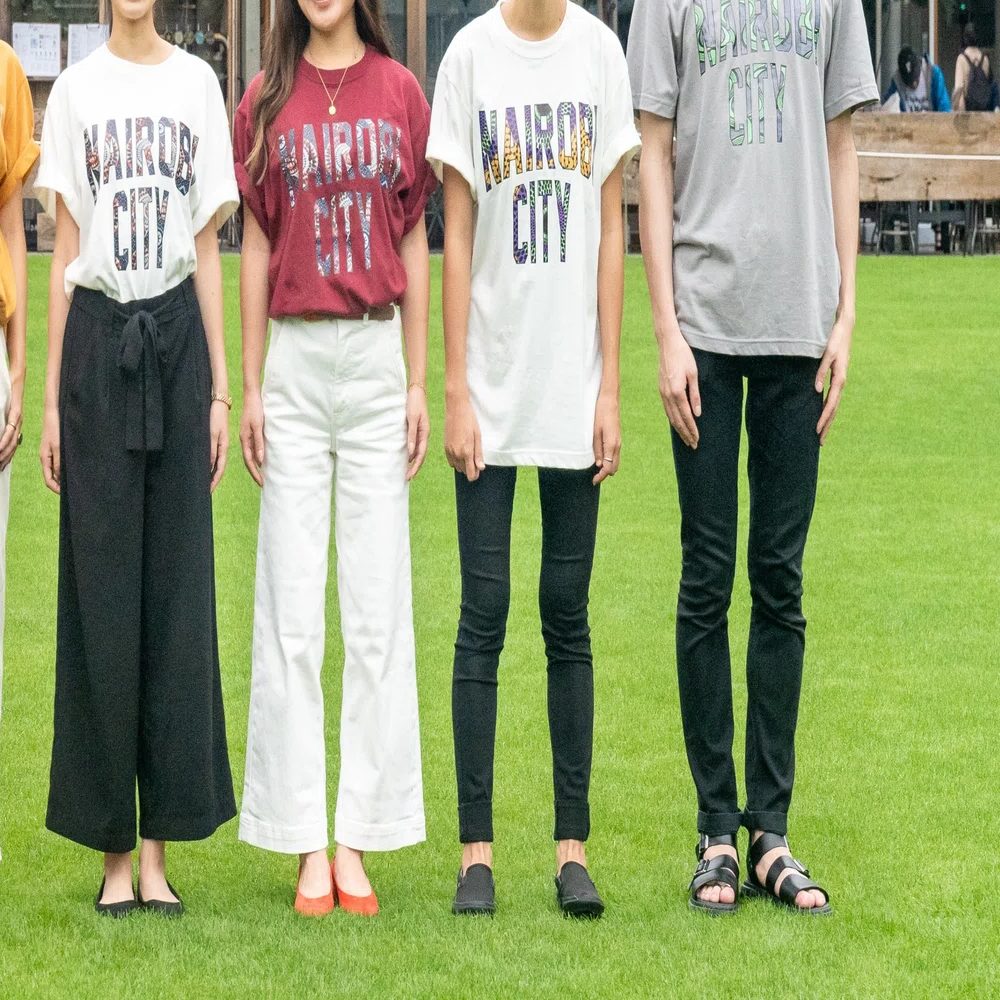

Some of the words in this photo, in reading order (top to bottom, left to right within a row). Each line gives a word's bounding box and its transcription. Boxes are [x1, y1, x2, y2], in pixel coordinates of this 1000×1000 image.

[728, 62, 787, 146] CITY
[112, 186, 170, 272] CITY
[313, 190, 372, 277] CITY
[512, 179, 571, 265] CITY
